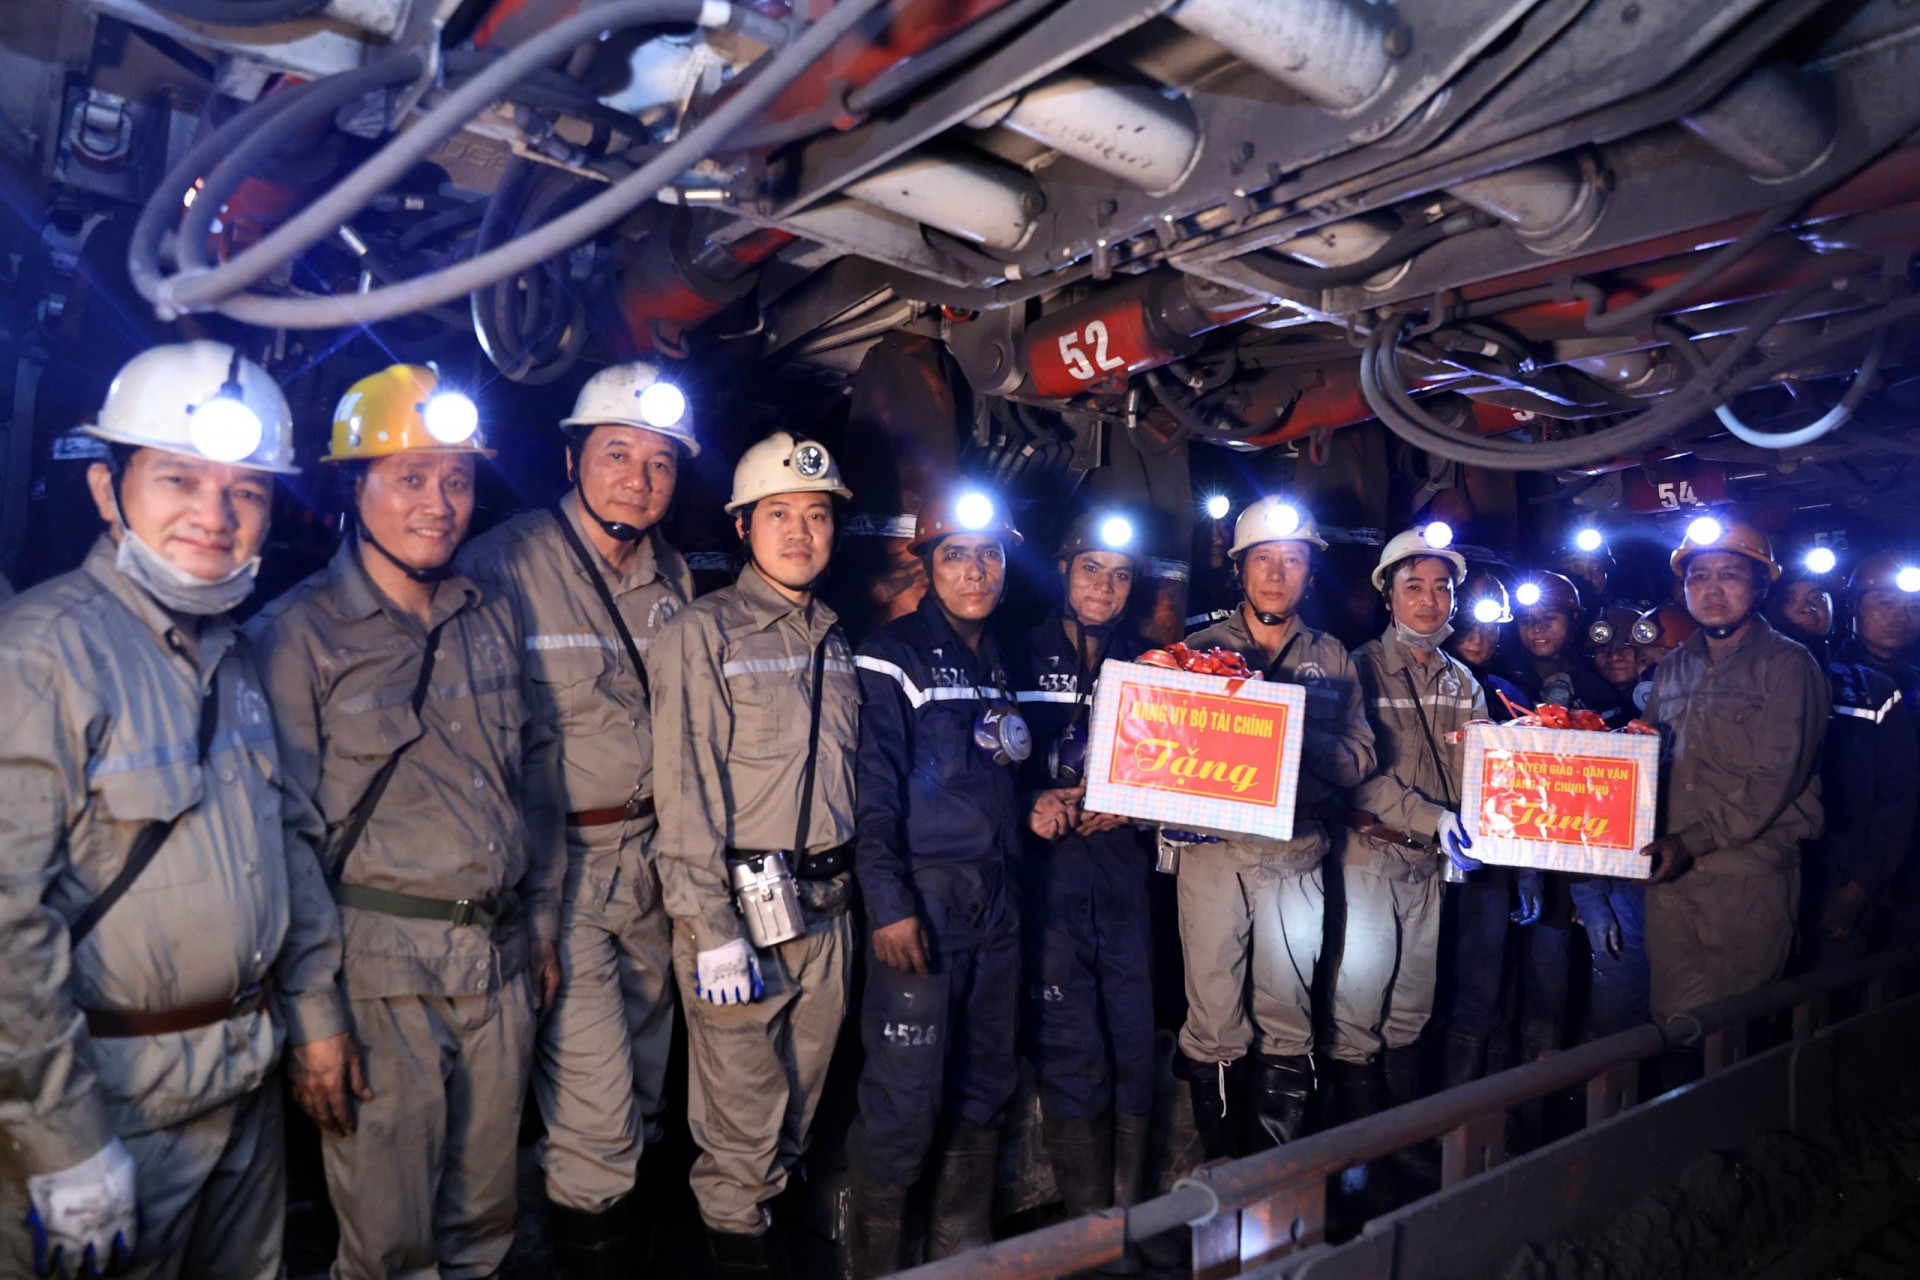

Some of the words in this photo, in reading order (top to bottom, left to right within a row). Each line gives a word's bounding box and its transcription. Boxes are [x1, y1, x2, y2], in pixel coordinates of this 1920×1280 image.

[1058, 319, 1125, 380] 52
[1658, 480, 1699, 508] 54
[1039, 673, 1078, 692] 4330
[1189, 706, 1208, 733] BỘ
[1210, 708, 1231, 732] TÀI
[1233, 713, 1274, 738] CHÍNH
[1134, 738, 1259, 793] Tặng
[1549, 766, 1574, 776] GIÁO
[1607, 767, 1629, 781] VẬN
[1554, 780, 1586, 794] CHÍNH
[883, 1021, 937, 1047] 4526
